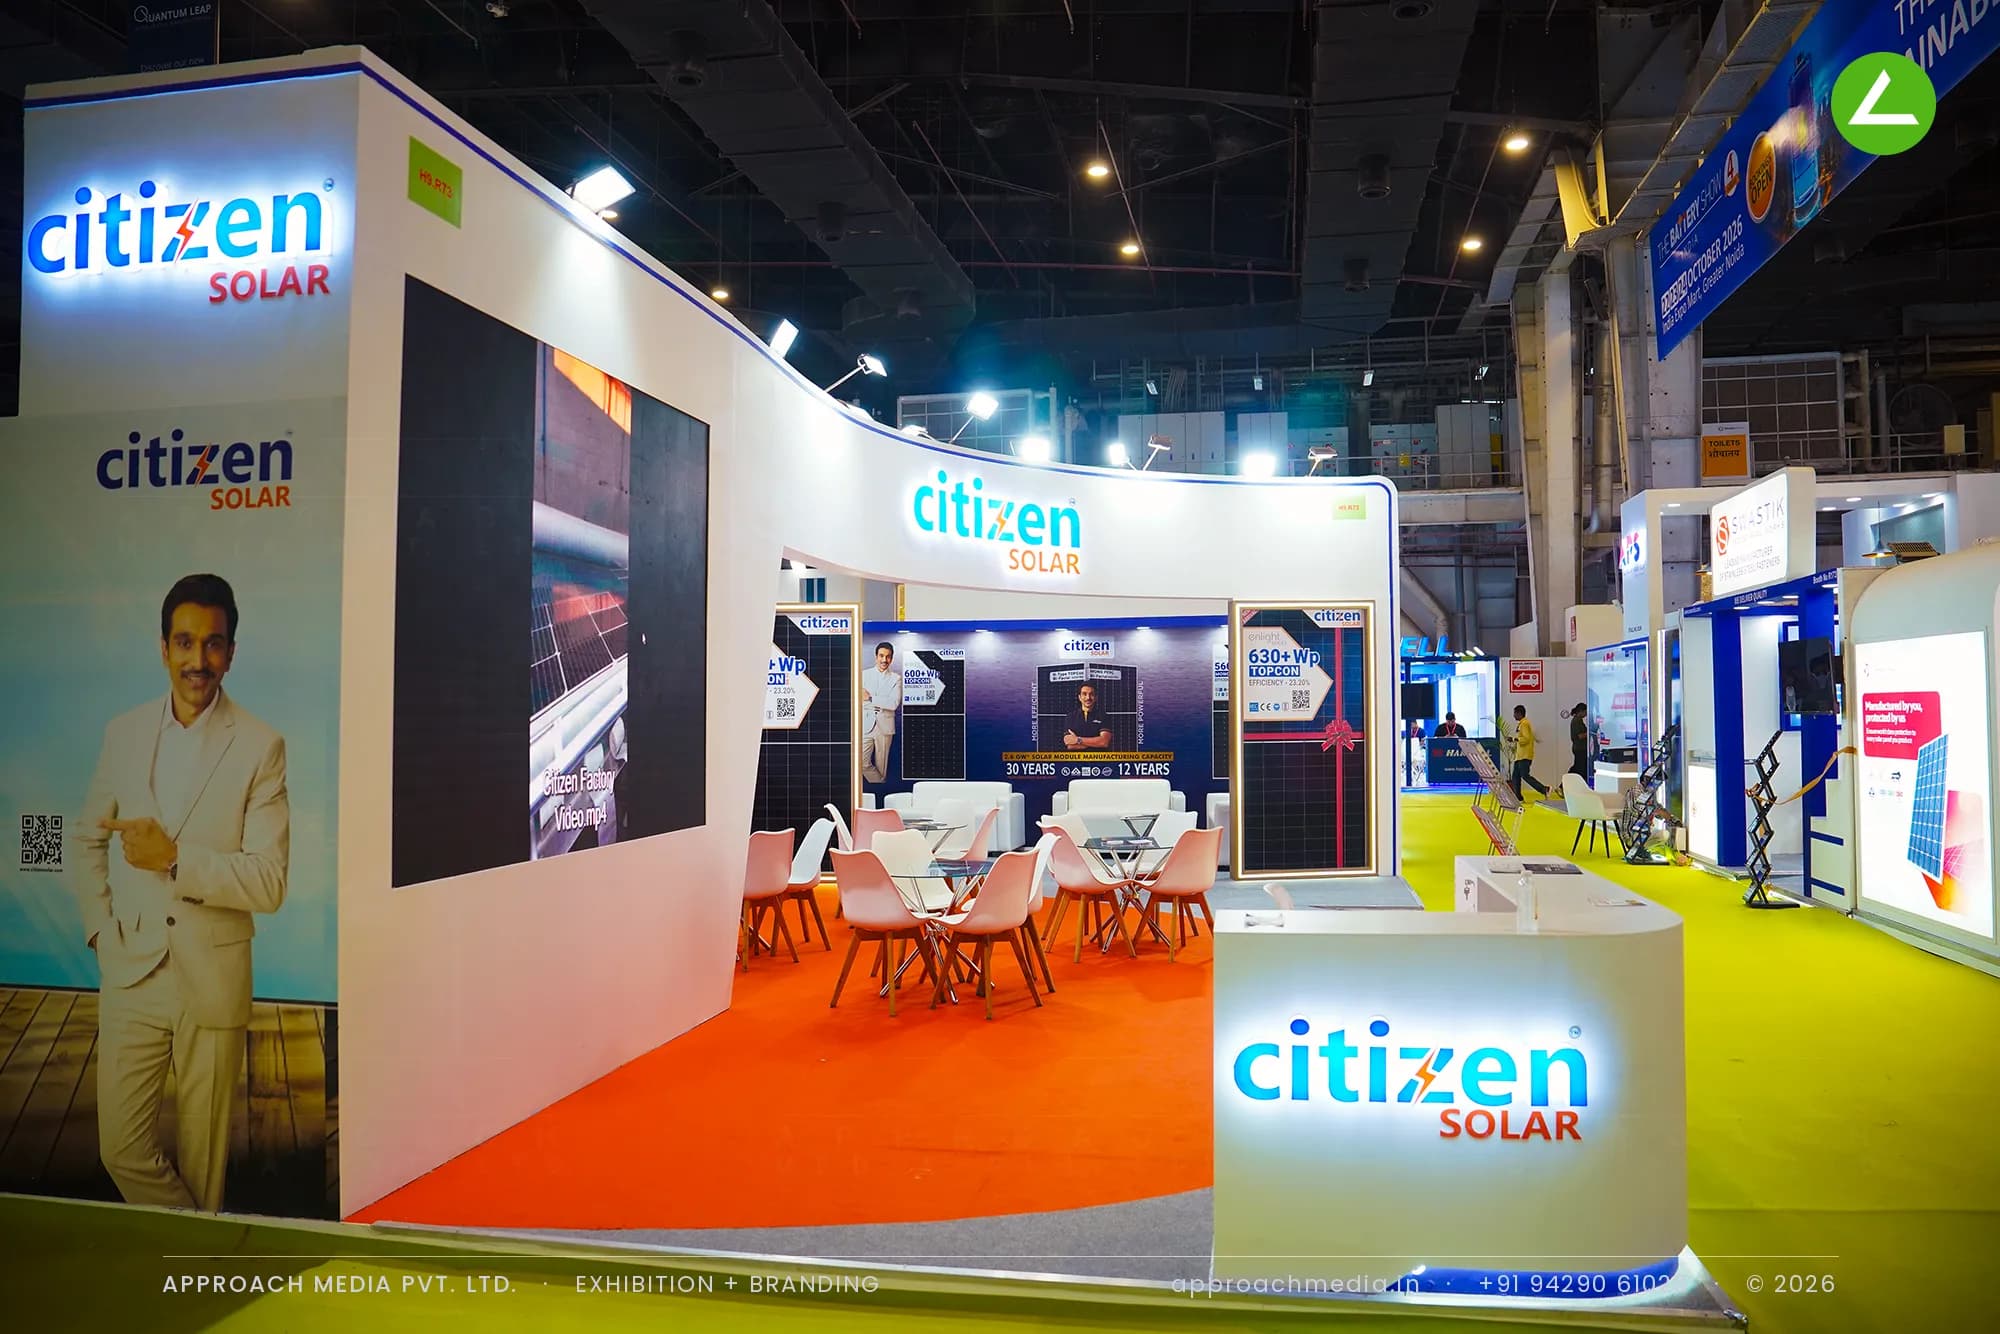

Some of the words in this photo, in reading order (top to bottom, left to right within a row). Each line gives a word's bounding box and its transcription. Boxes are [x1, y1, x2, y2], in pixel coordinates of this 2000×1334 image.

[134, 5, 188, 23] QUANTUM
[190, 4, 212, 16] LEAP
[1894, 0, 1935, 35] TH
[1751, 170, 1772, 204] OPEN
[1669, 195, 1700, 249] BATTERY
[1700, 168, 1722, 211] SHOW
[27, 180, 323, 273] citizen
[1688, 239, 1722, 287] OCTOBER
[1722, 214, 1743, 253] 2026
[209, 264, 330, 304] SOLAR
[1663, 313, 1675, 336] India
[1675, 302, 1687, 323] Expo
[1703, 262, 1725, 293] Greater
[1725, 244, 1745, 273] Noida
[96, 429, 293, 489] citizen
[210, 486, 290, 509] SOLAR
[913, 470, 1081, 548] citizen
[1009, 548, 1081, 574] SOLAR
[800, 616, 848, 628] citizen
[1314, 609, 1361, 621] citizen
[1064, 639, 1109, 651] citizen
[1248, 632, 1280, 642] enlight
[1250, 666, 1299, 676] TOPCON
[544, 768, 578, 796] Citizen
[580, 767, 615, 794] Factory
[1006, 763, 1019, 775] 30
[1021, 763, 1056, 775] YEARS
[1118, 762, 1131, 775] 12
[1134, 762, 1170, 775] YEARS
[554, 801, 607, 831] Video.mp4
[1233, 1018, 1588, 1107] citizen
[1439, 1108, 1582, 1141] SOLAR
